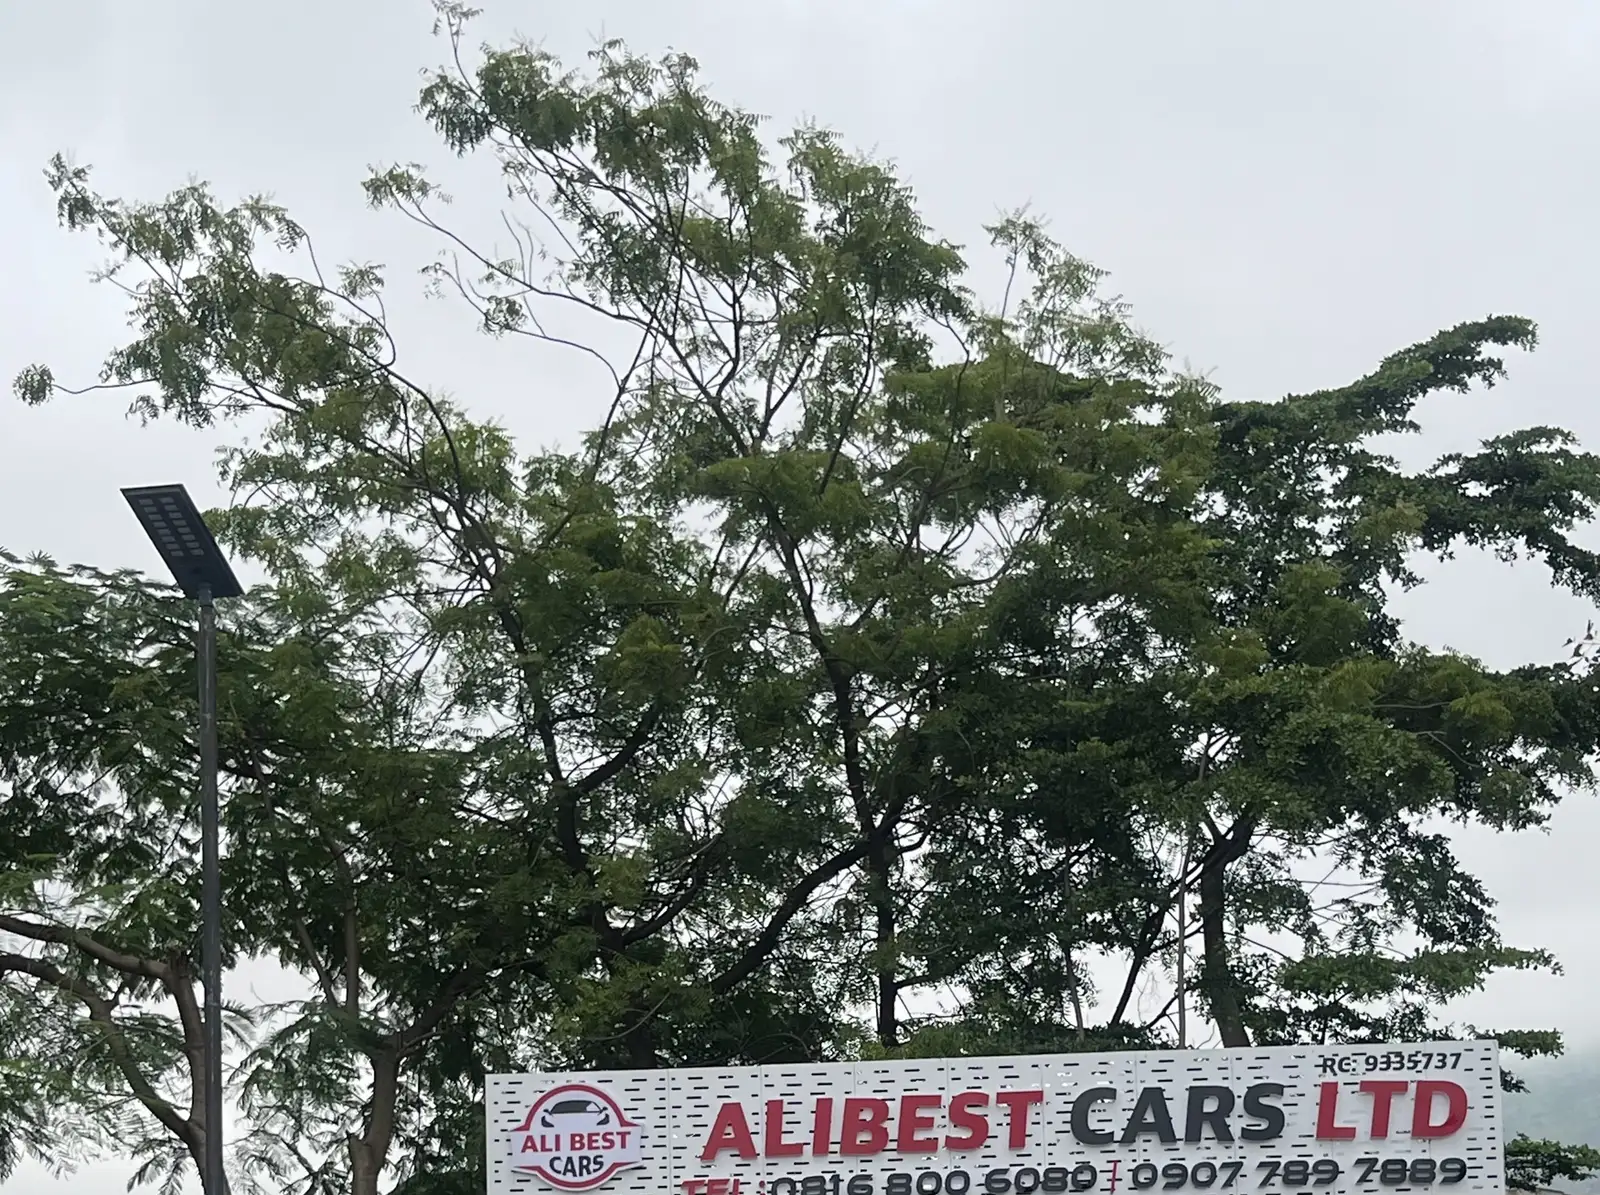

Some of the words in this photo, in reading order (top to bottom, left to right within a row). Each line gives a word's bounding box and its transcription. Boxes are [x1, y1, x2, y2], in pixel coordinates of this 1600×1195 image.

[1365, 1053, 1461, 1071] 9335737
[700, 1090, 1044, 1161] ALIBEST
[1070, 1082, 1286, 1145] CARS
[1316, 1080, 1469, 1141] LTD
[521, 1134, 561, 1153] ALI
[570, 1131, 632, 1151] BEST
[549, 1154, 605, 1177] CARS
[984, 1164, 1098, 1194] 6080
[1132, 1161, 1244, 1190] 0907
[1256, 1159, 1340, 1188] 789
[1353, 1157, 1468, 1186] 7889
